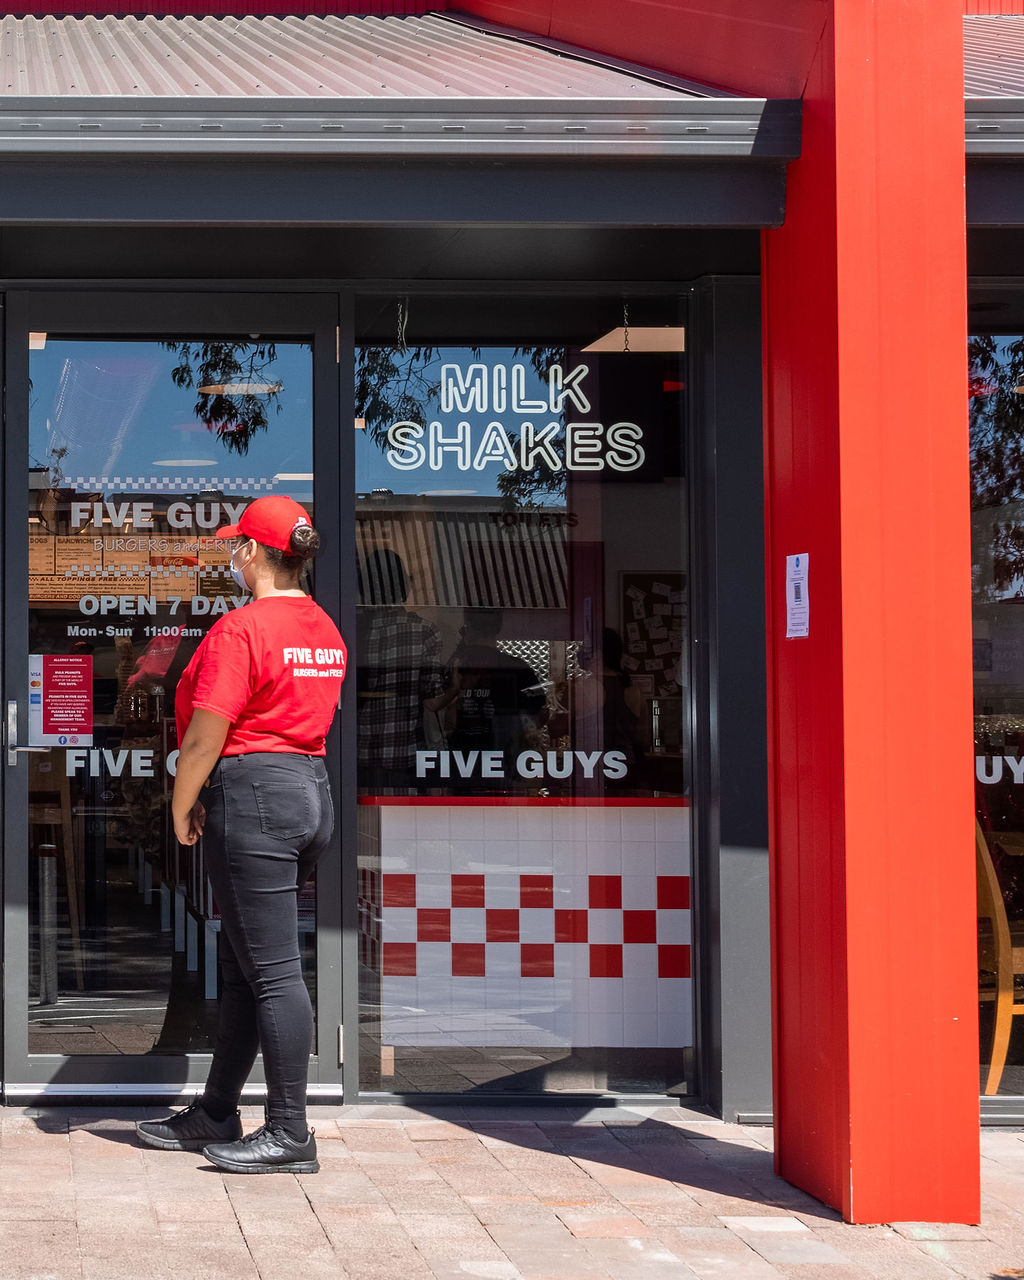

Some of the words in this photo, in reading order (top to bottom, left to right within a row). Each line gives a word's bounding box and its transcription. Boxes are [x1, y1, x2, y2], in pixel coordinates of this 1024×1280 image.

[441, 364, 591, 414] MILK
[387, 421, 645, 471] SHAKES
[71, 502, 154, 528] FIVE
[167, 502, 248, 529] GUY
[93, 539, 168, 552] BURGERS
[173, 539, 200, 552] and
[205, 539, 236, 552] FRIE
[79, 595, 157, 616] OPEN
[166, 596, 182, 615] 7
[191, 596, 252, 615] DAY
[283, 648, 313, 664] FIVE
[315, 648, 344, 665] GUY
[66, 749, 154, 777] FIVE
[416, 750, 505, 778] FIVE
[516, 750, 628, 779] GUYS
[976, 756, 1024, 784] UY
